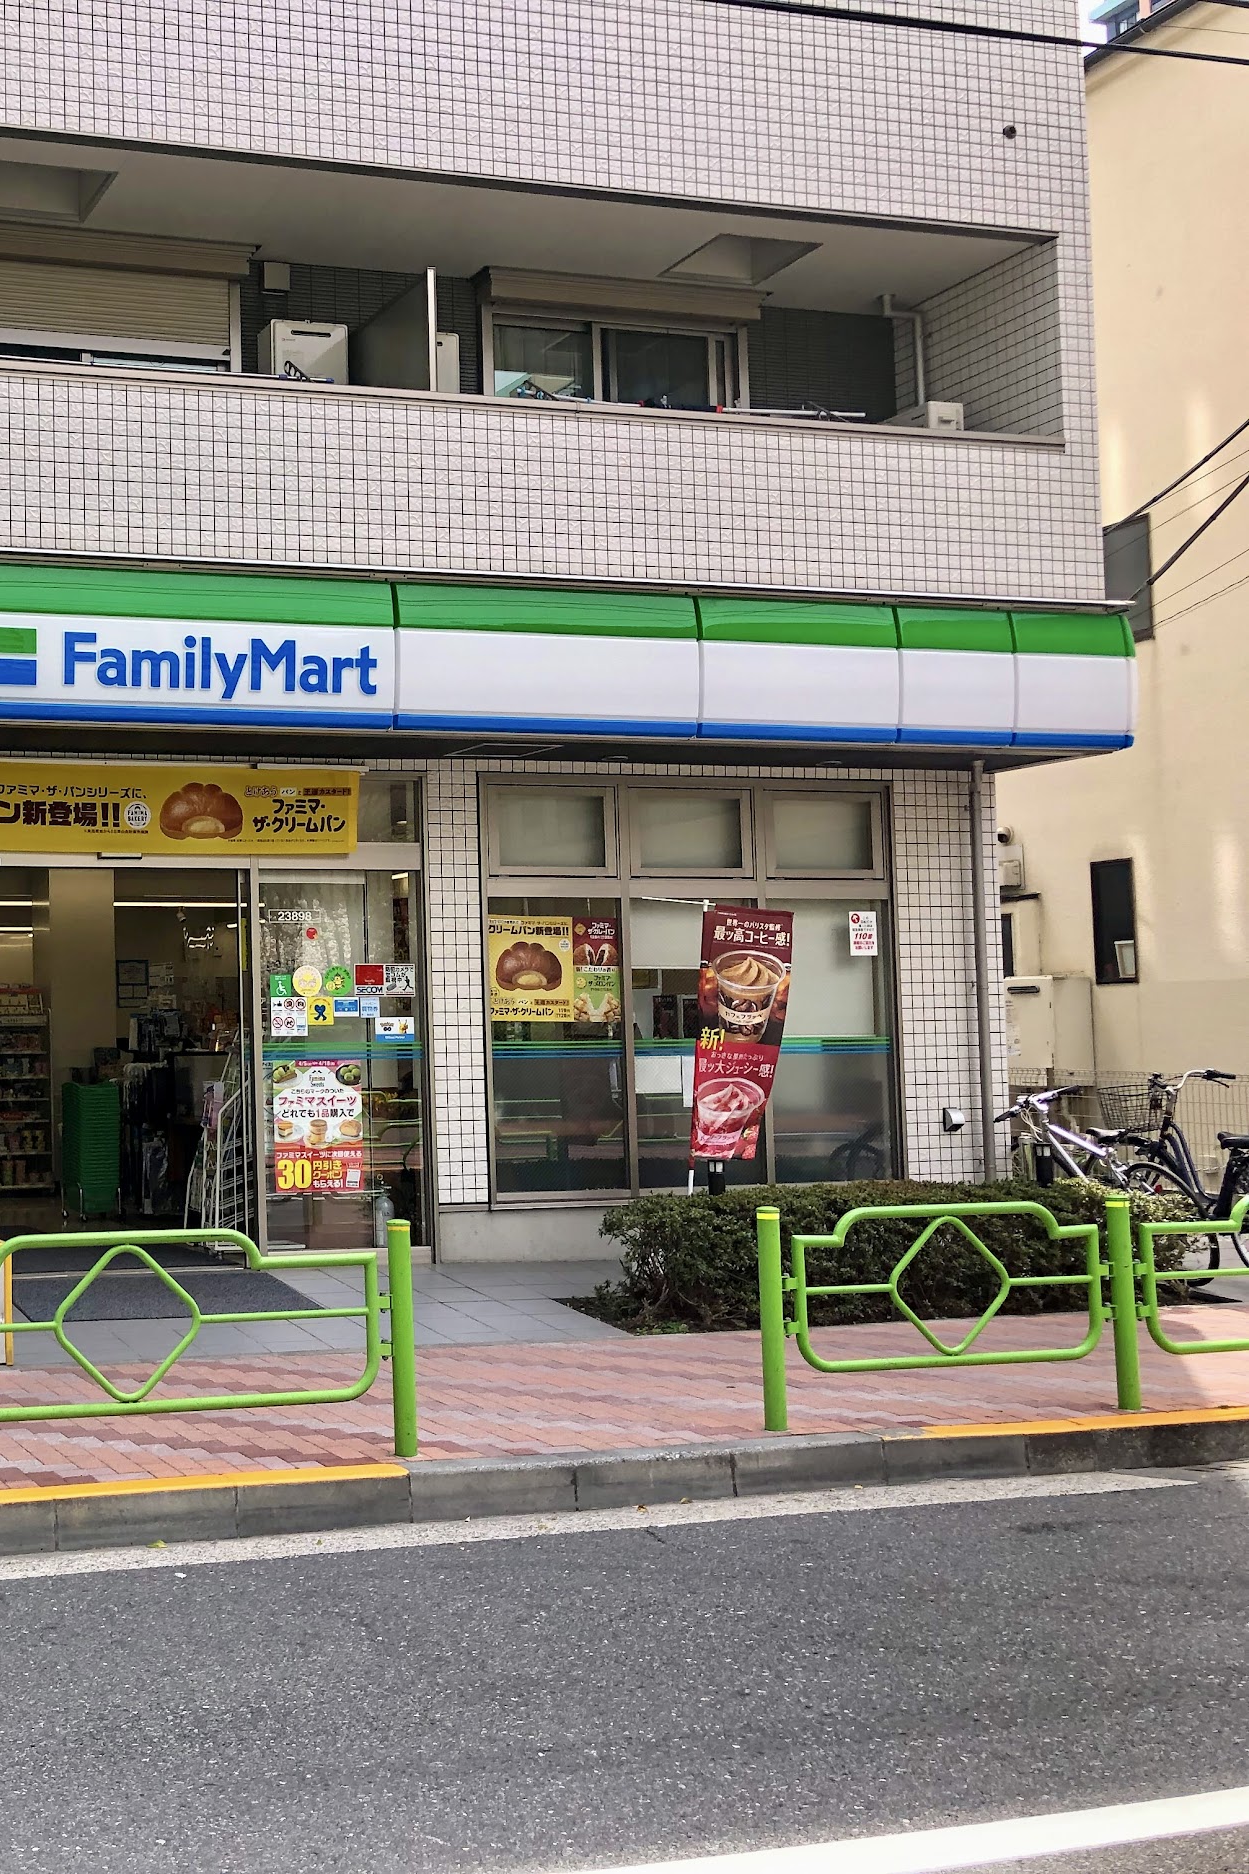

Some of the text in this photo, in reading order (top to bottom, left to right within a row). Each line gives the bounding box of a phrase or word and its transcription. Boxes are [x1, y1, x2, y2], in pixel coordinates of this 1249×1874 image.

[63, 631, 378, 700] FamilyMart
[277, 911, 312, 921] 23898
[356, 986, 383, 994] SECOM
[699, 1026, 726, 1052] 新!
[278, 1095, 357, 1107] ファミマスイーツ
[312, 1160, 342, 1171] 円引き
[277, 1159, 312, 1190] 30
[312, 1170, 343, 1180] クーポン
